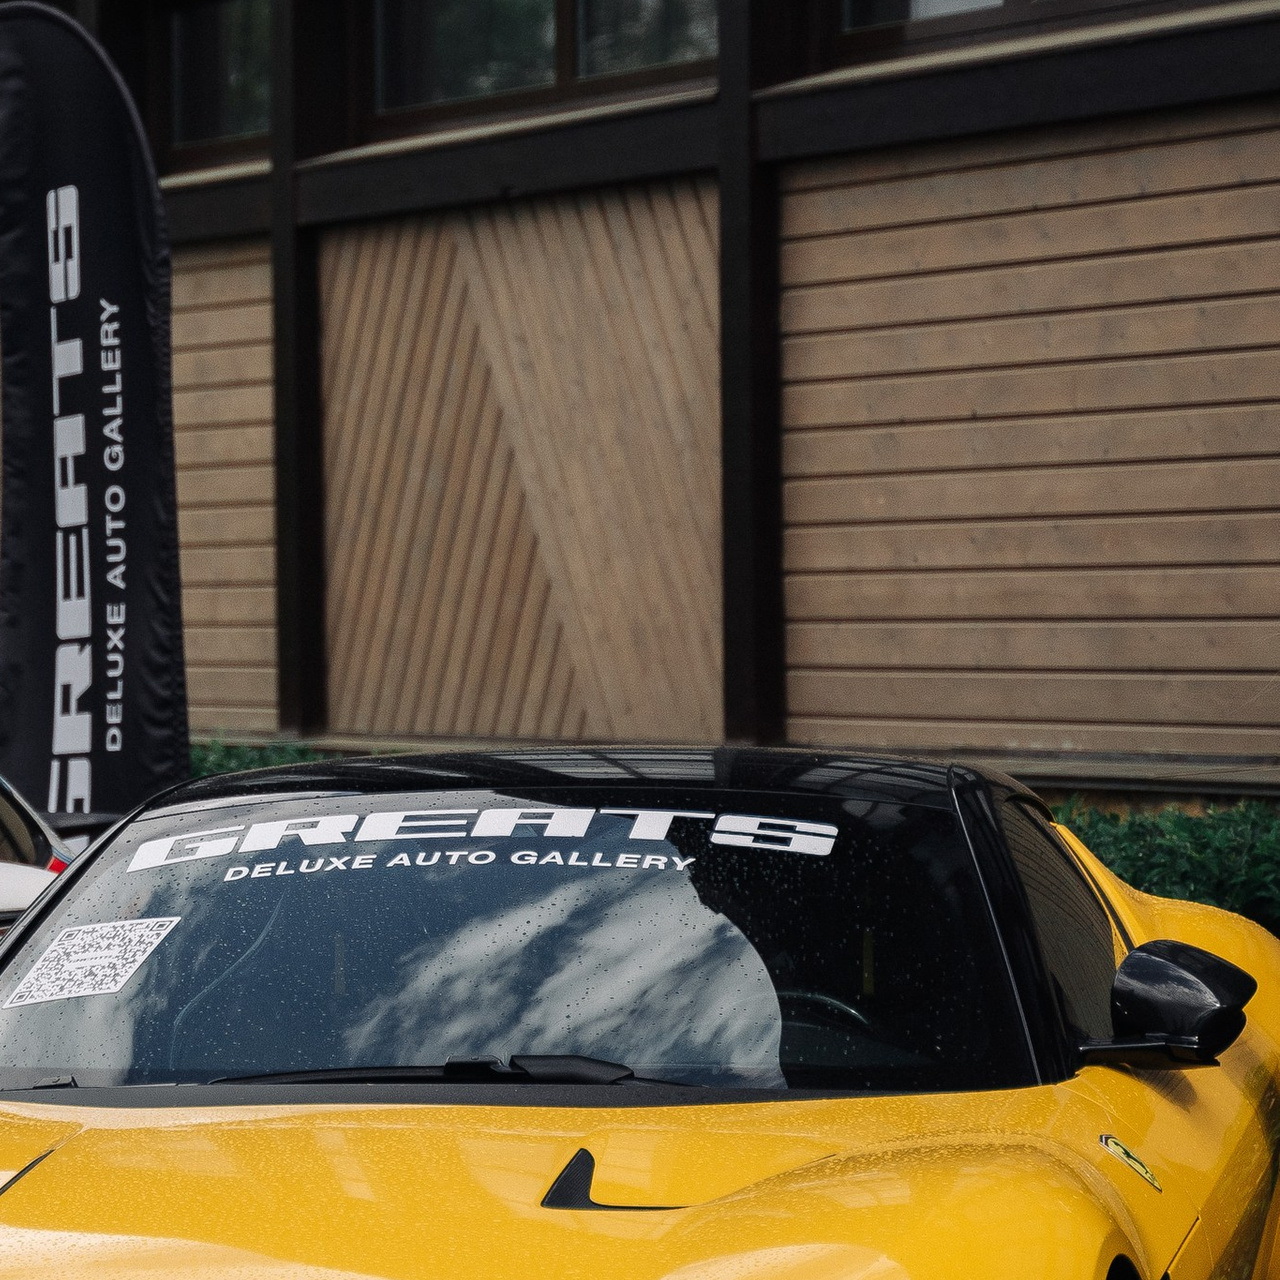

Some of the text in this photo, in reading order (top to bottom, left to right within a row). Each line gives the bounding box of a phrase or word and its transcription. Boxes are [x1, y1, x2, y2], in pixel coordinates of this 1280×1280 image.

[99, 297, 127, 752] DELUXE AUTO GALLERY
[126, 807, 840, 874] GREATS
[223, 848, 697, 883] DELUXE AUTO GALLERY
